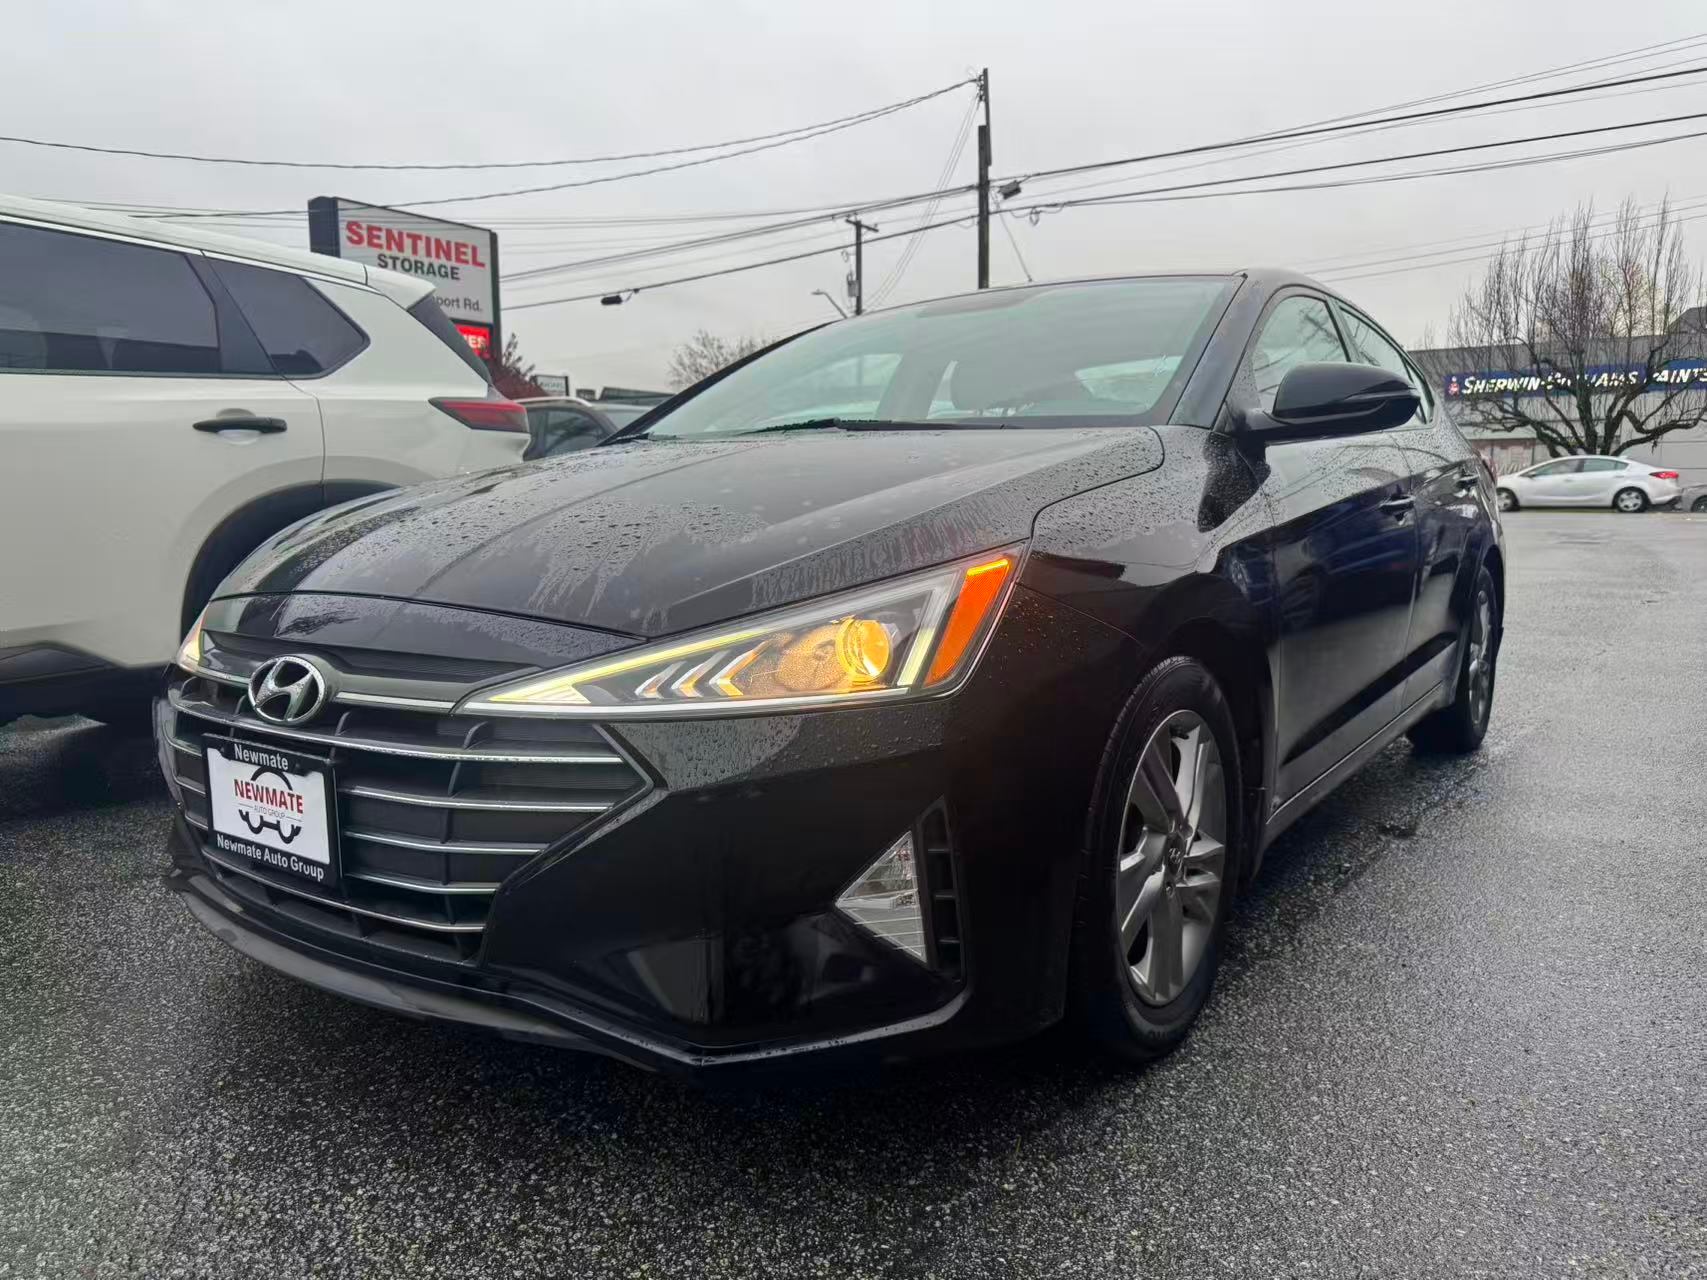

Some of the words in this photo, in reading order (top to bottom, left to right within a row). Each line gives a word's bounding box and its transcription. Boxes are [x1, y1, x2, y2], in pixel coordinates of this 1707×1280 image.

[346, 220, 486, 268] SENTINEL
[377, 253, 461, 281] STORAGE
[432, 296, 460, 313] port
[463, 298, 484, 312] Rd.
[234, 743, 289, 771] Newmate
[234, 779, 304, 814] NEWMATE
[217, 834, 262, 860] Newmate
[263, 847, 288, 868] Auto
[290, 856, 324, 881] Group
